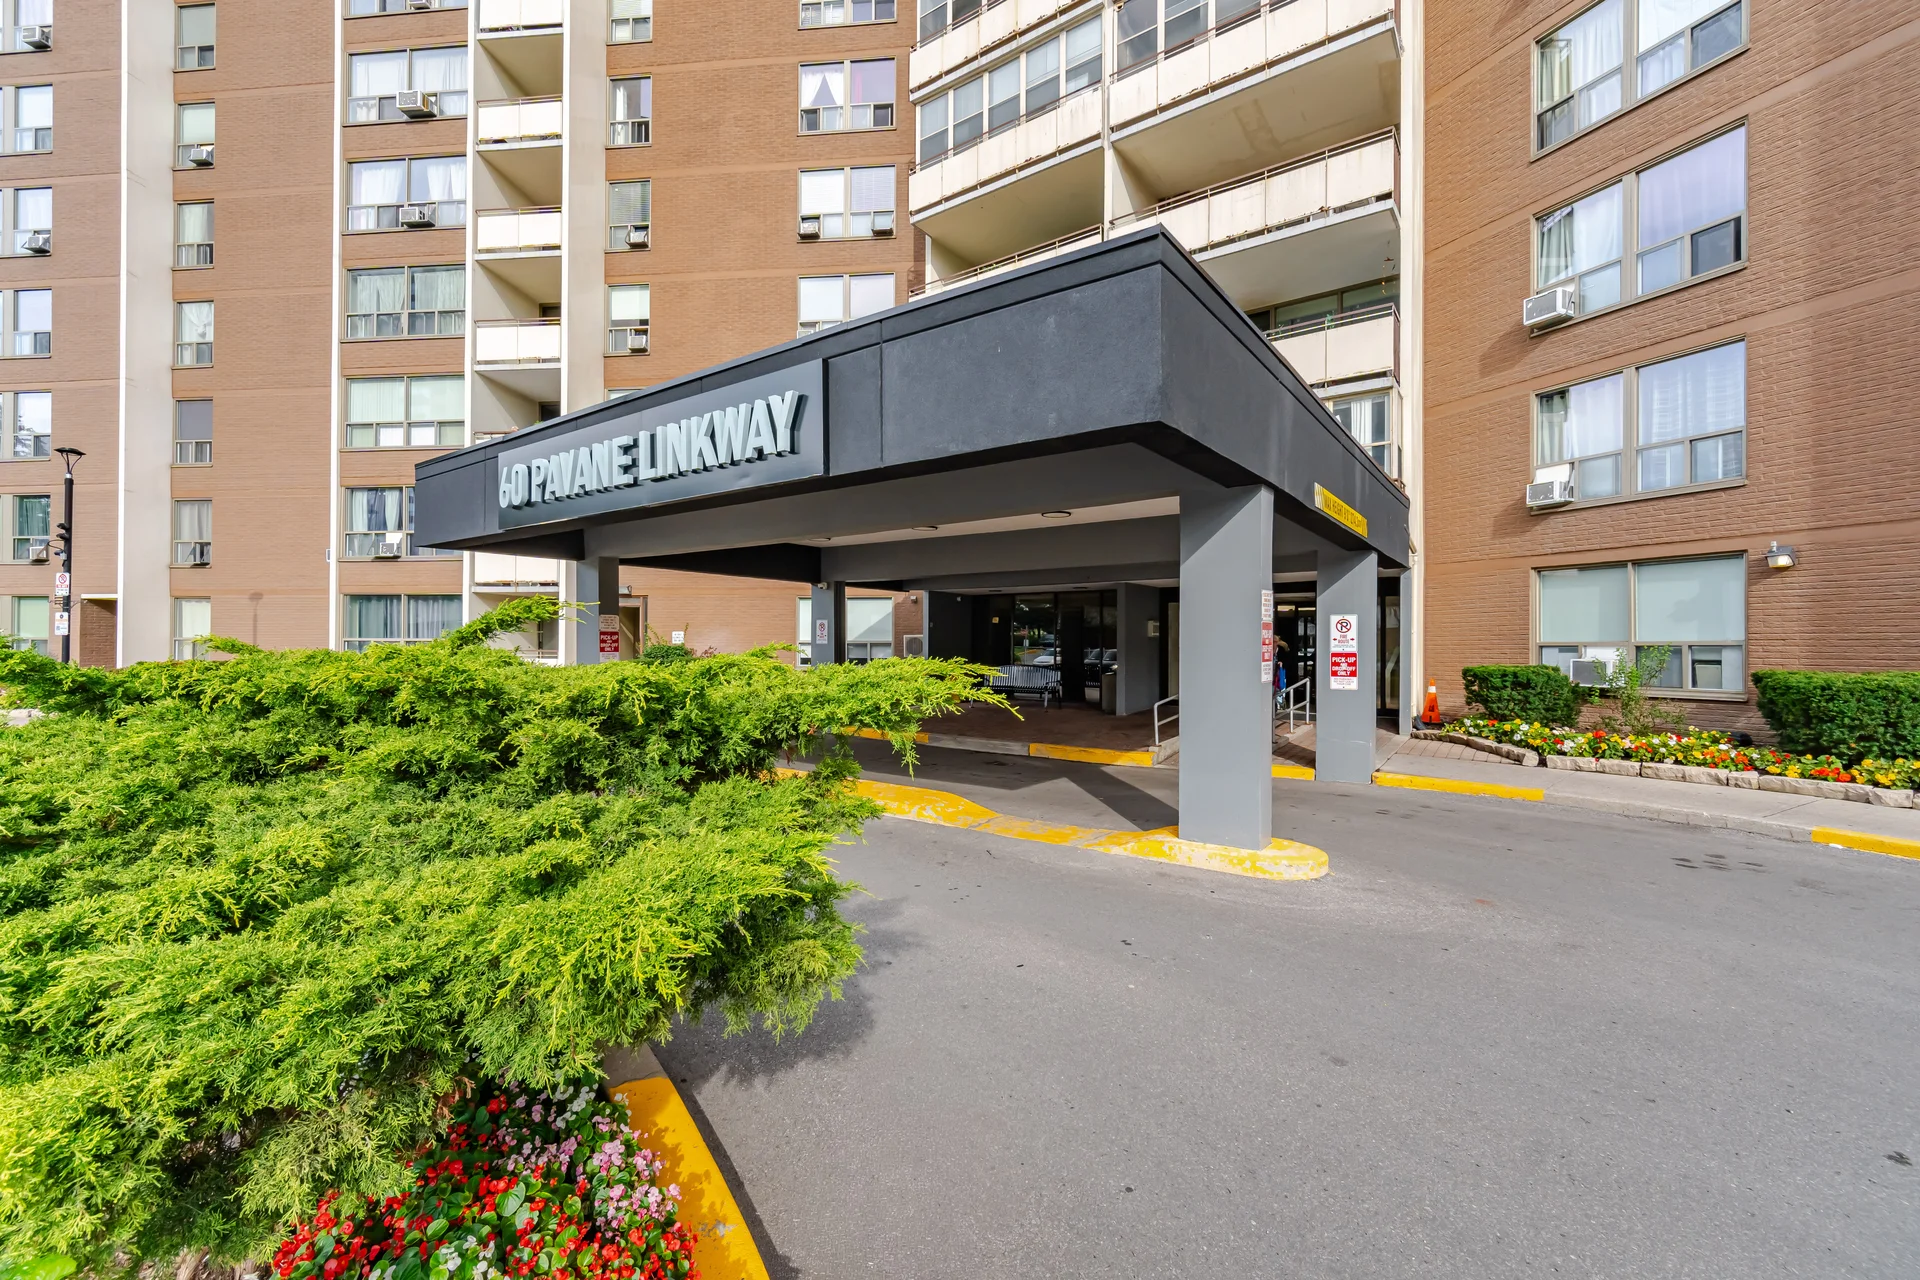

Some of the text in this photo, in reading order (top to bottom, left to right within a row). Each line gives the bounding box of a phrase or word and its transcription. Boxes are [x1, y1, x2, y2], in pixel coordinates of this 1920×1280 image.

[499, 390, 800, 509] 60 PAVANE LINKWAY
